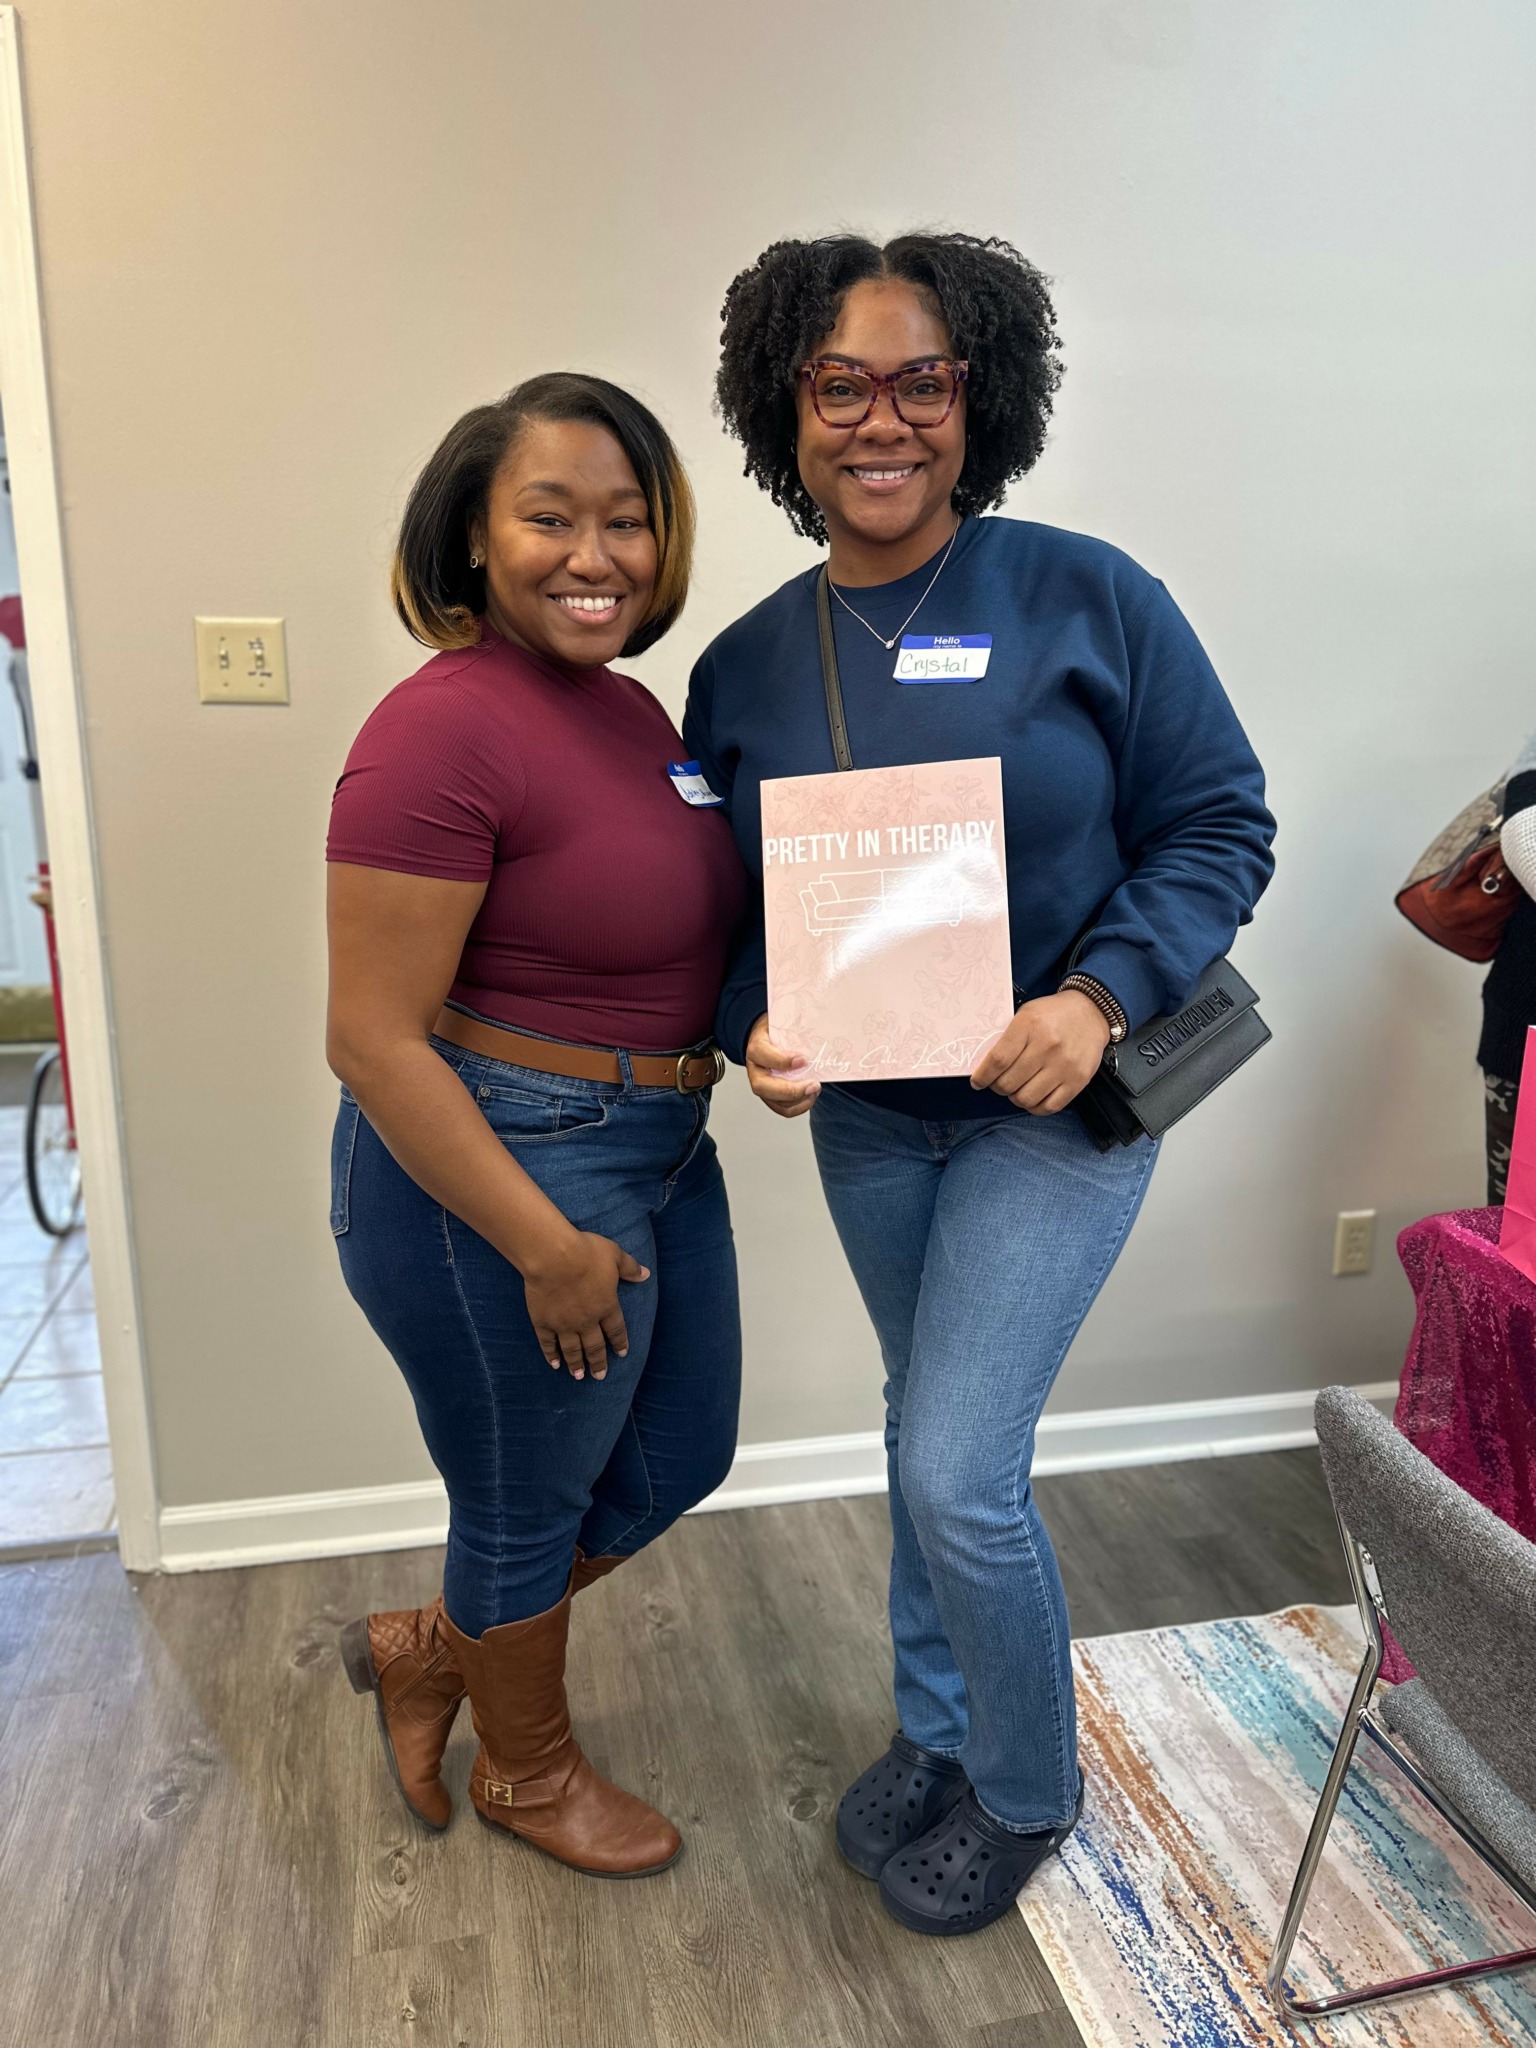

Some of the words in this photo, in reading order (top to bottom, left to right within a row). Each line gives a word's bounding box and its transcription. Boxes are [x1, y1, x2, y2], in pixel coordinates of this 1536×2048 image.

[934, 636, 961, 645] Hello
[900, 653, 968, 677] Crystal
[765, 831, 850, 865] PRETTY
[856, 828, 880, 858] IN
[886, 819, 996, 856] THERAPY
